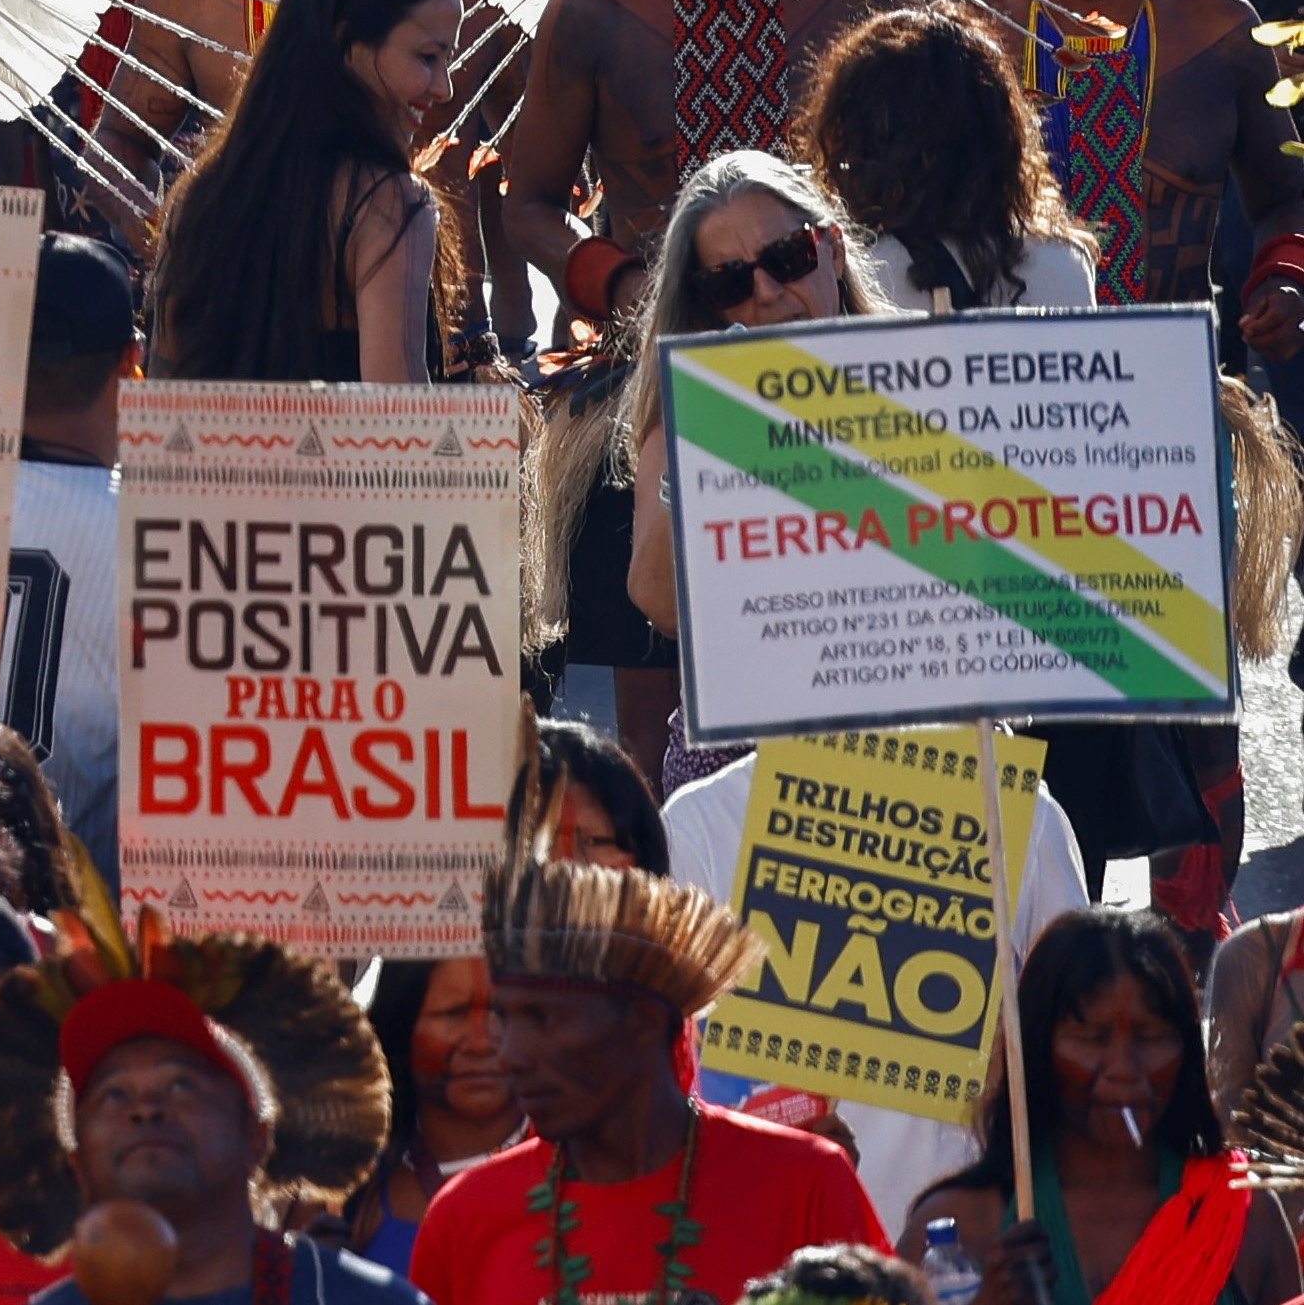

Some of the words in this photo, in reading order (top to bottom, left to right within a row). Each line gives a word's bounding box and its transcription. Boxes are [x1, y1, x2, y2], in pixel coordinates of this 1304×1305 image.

[757, 357, 951, 401] GOVERNO
[965, 351, 1134, 386] FEDERAL
[768, 407, 947, 449] MINISTÉRIO
[958, 407, 1000, 432] DA
[1010, 401, 1129, 433] JUSTIÇA
[698, 466, 821, 493] Fundação
[831, 452, 940, 482] Nacional
[950, 448, 993, 470] dos
[1003, 445, 1077, 467] Povos
[1085, 442, 1196, 470] Indígenas
[705, 508, 892, 562] TERRA
[908, 493, 1202, 546] PROTEGIDA
[134, 520, 490, 597] ENERGIA
[741, 592, 825, 616] ACESSO
[826, 580, 961, 607] INTERDITADO
[1075, 573, 1184, 592] ESTRANHAS
[761, 618, 837, 640] ARTIGO
[906, 611, 936, 628] DA
[939, 598, 1081, 625] CONSTITUIÇÃO
[1084, 599, 1164, 617] FEDERAL
[132, 600, 503, 675] POSITIVA
[820, 639, 896, 662] ARTIGO
[996, 630, 1025, 647] LEI
[812, 664, 887, 688] ARTIGO
[956, 658, 985, 675] DO
[990, 649, 1067, 673] CÓDIGO
[226, 676, 360, 722] PARA
[374, 680, 405, 718] O
[138, 723, 505, 821] BRASIL
[774, 771, 943, 835] TRILHOS
[753, 862, 996, 940] FERROGRÃO
[737, 910, 988, 1038] NÃO
